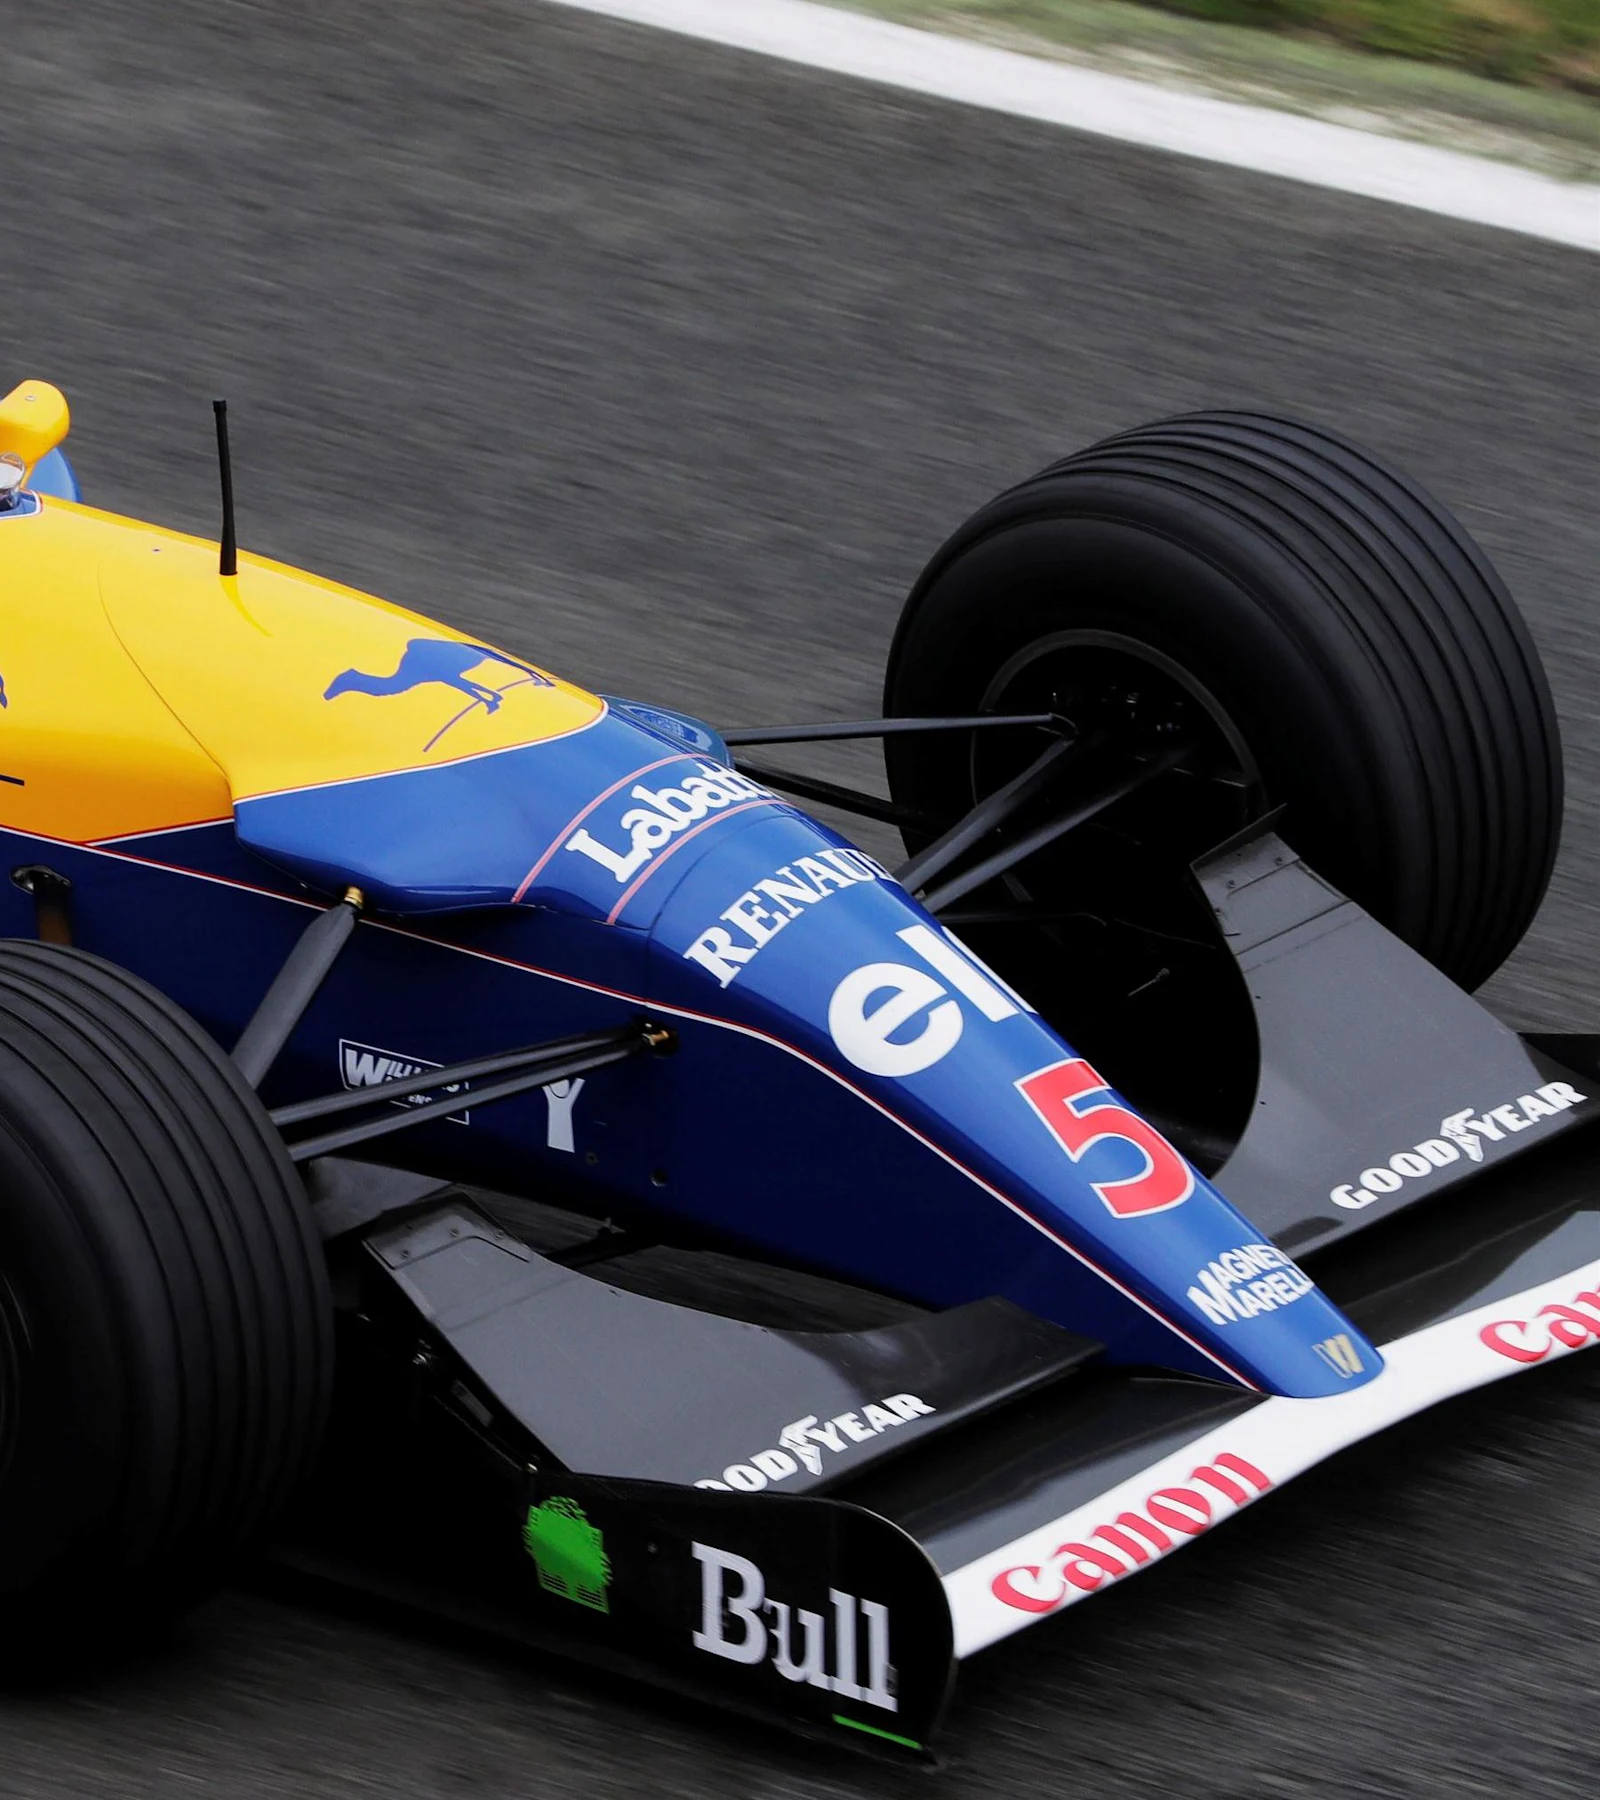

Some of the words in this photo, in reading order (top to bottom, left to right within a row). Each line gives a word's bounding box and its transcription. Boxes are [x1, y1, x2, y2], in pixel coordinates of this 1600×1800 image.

[828, 923, 1040, 1077] el
[1012, 1057, 1196, 1220] 5
[1329, 1080, 1588, 1210] GOODYEAR
[988, 1450, 1274, 1614] Canon
[691, 1540, 899, 1712] Bull
